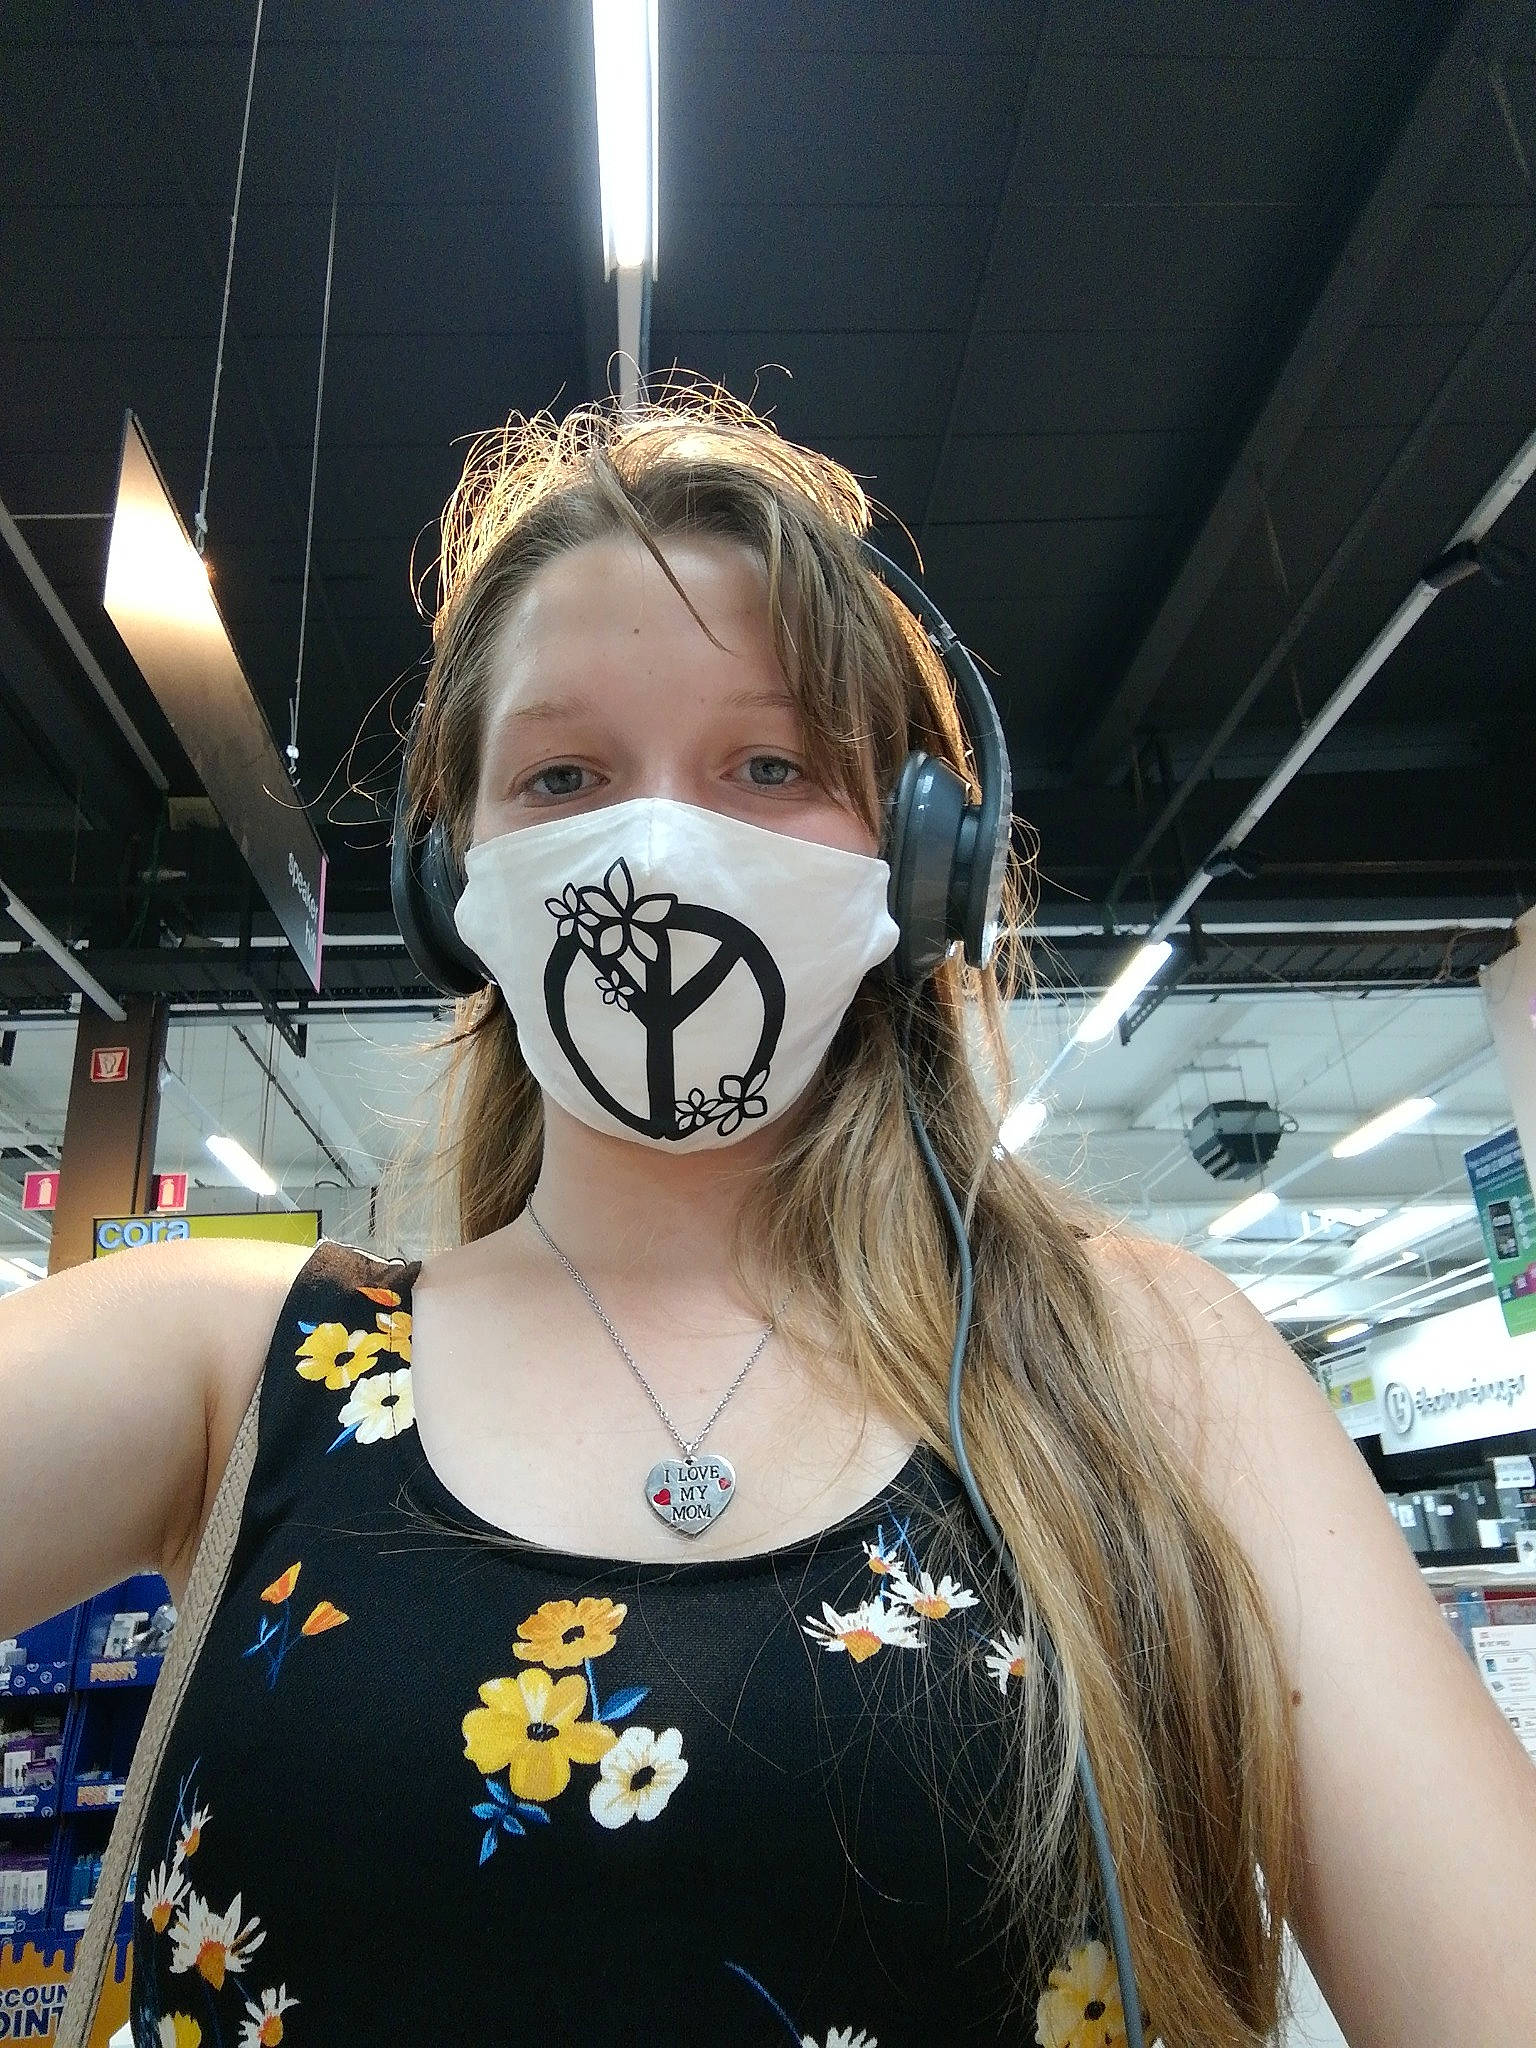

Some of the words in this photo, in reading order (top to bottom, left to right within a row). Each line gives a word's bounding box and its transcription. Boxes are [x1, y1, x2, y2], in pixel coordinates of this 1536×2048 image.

[97, 1219, 190, 1249] cora
[664, 1469, 670, 1484] I
[677, 1465, 720, 1482] LOVE
[680, 1485, 708, 1501] MY
[671, 1503, 713, 1521] MOM
